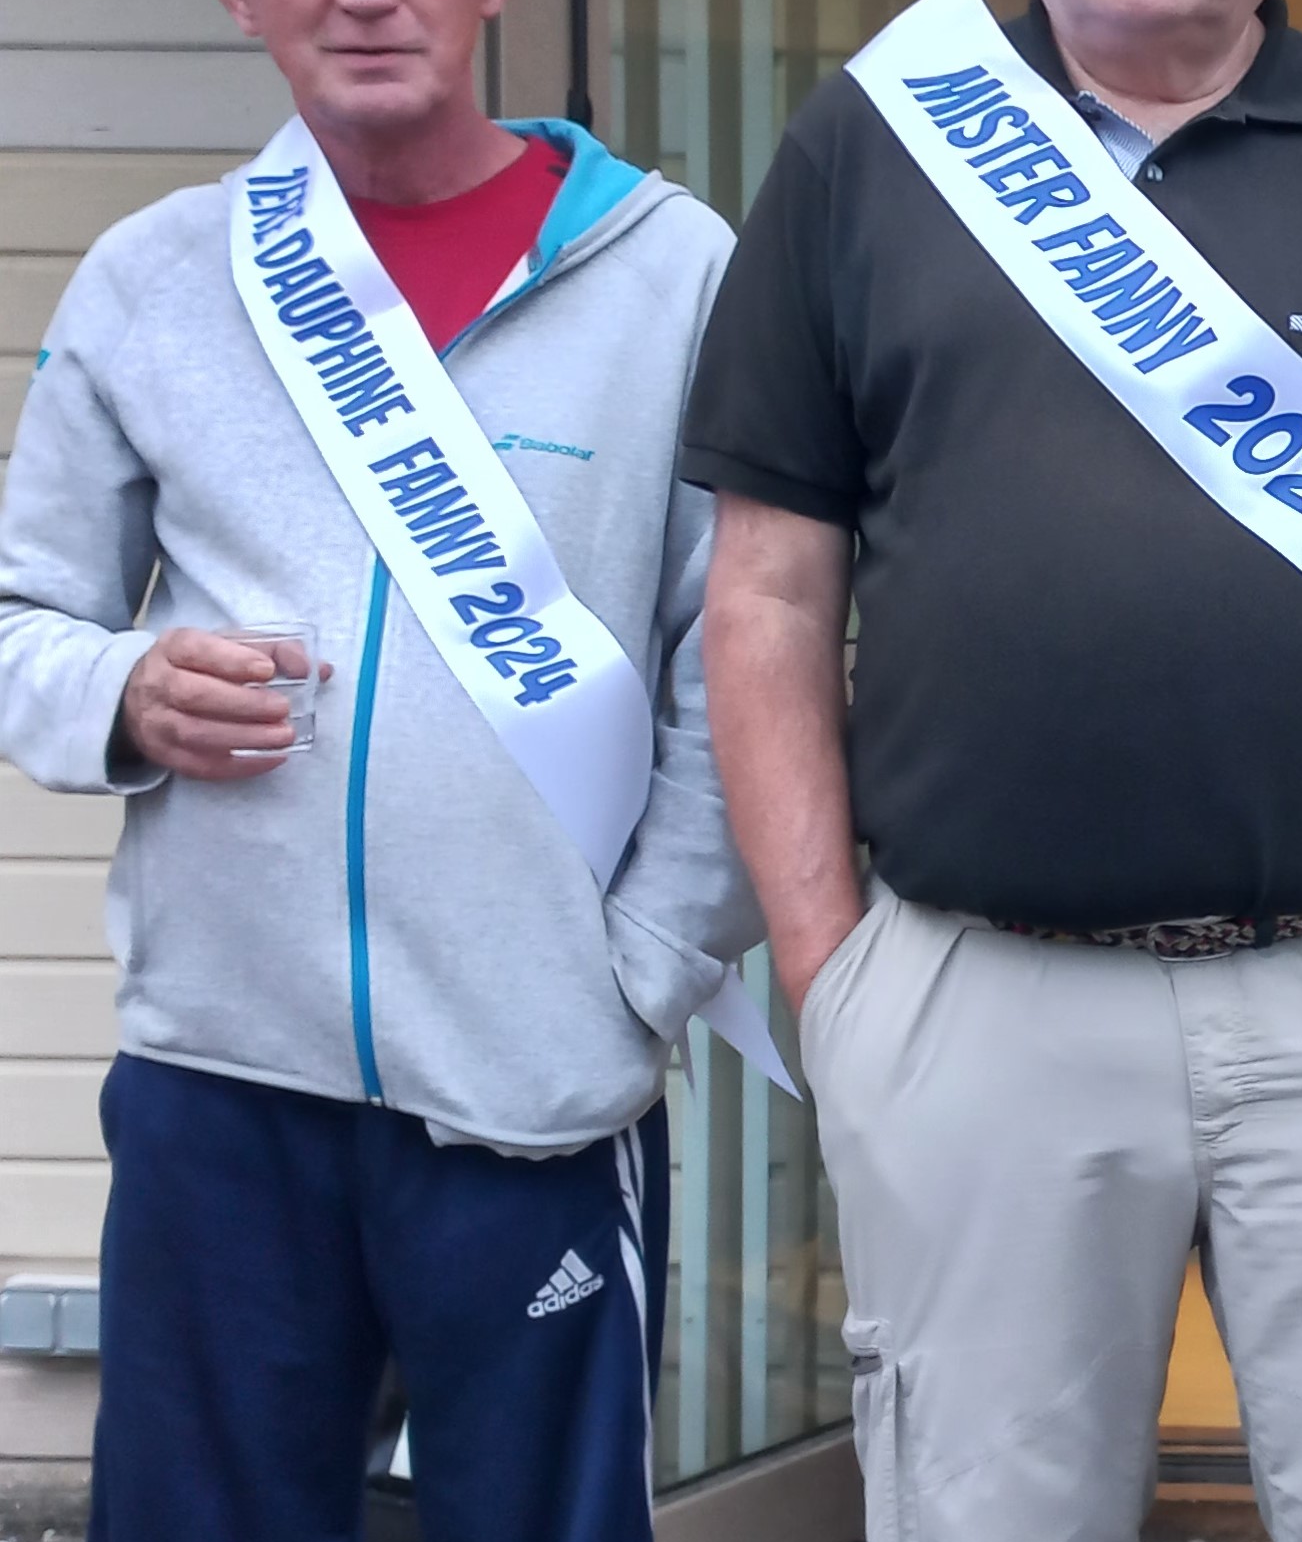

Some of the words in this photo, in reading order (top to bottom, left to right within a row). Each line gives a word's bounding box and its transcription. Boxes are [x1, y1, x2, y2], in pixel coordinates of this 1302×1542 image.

[902, 64, 1092, 226] MISTER
[1031, 212, 1219, 375] FANNY
[254, 227, 414, 438] DAUPHINE
[368, 436, 508, 577] FANNY
[449, 581, 579, 708] 2024
[527, 1273, 604, 1318] adidas
